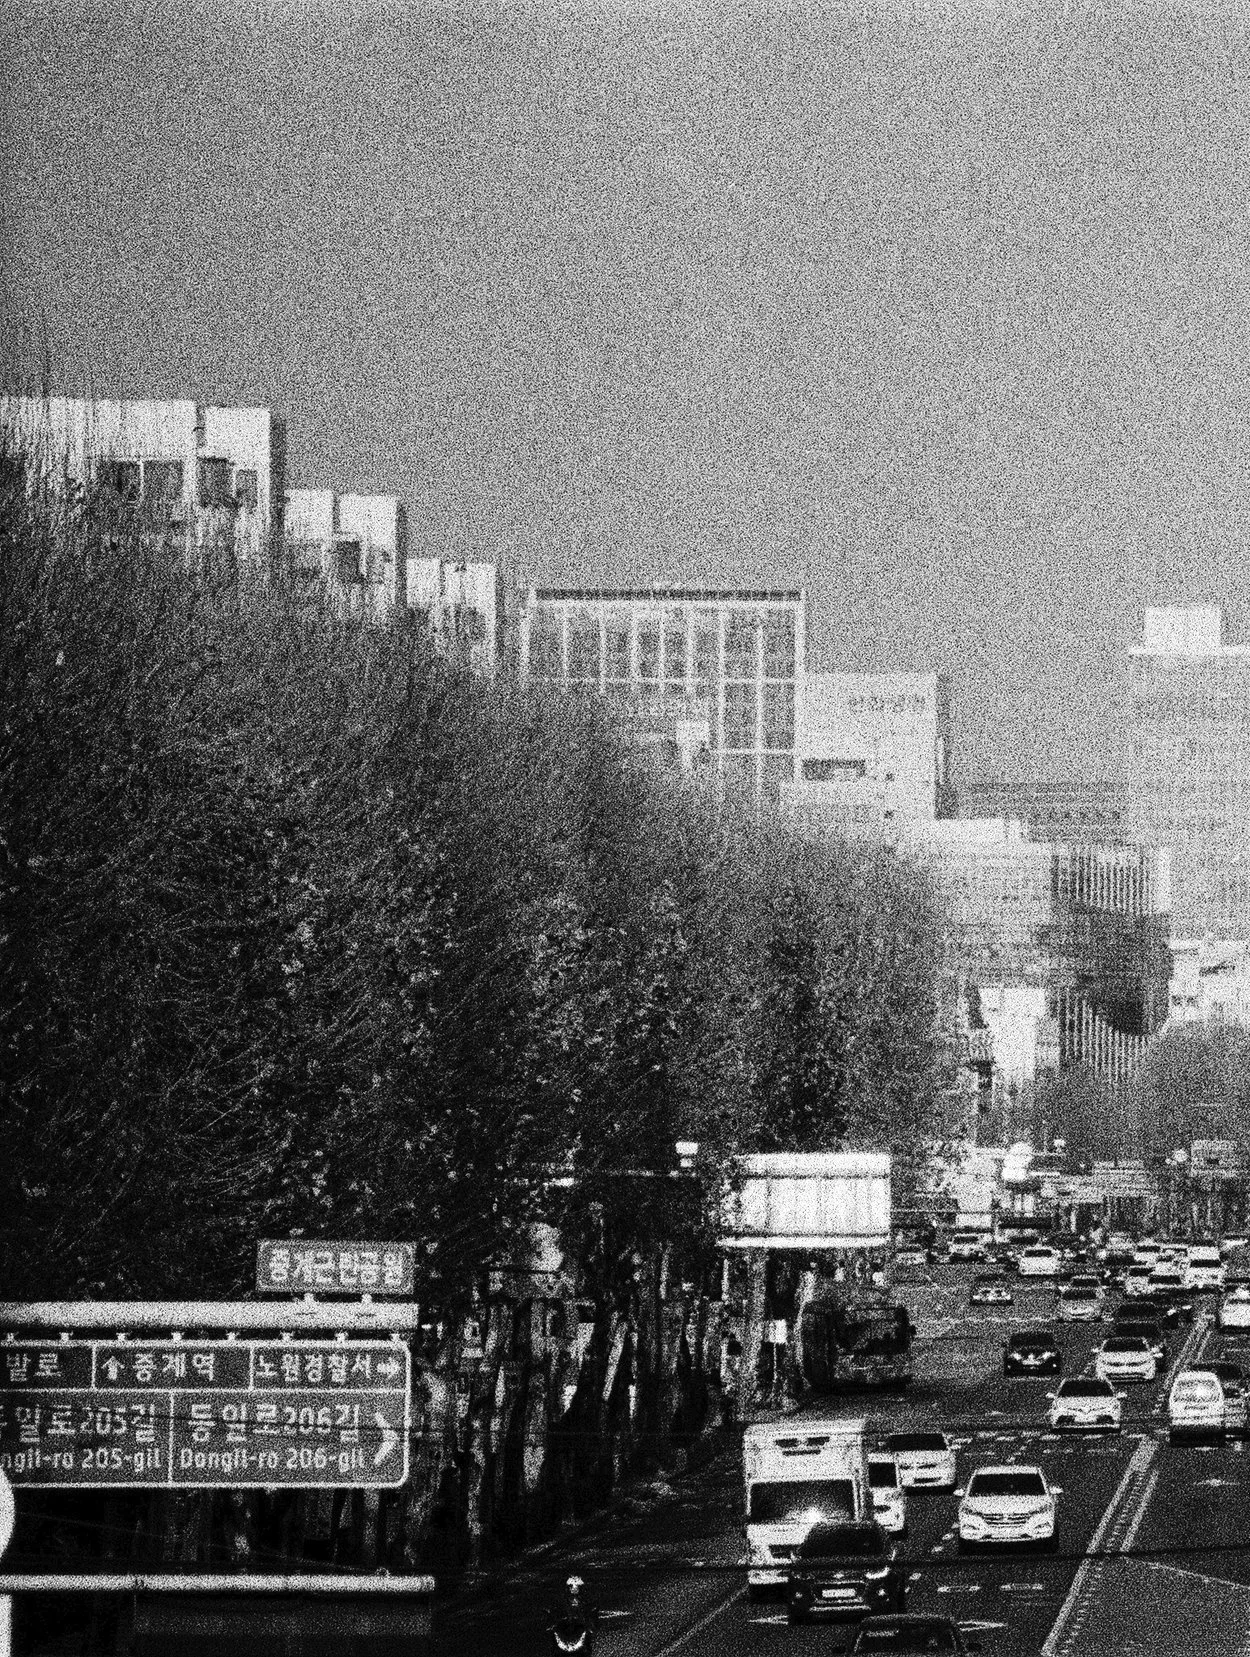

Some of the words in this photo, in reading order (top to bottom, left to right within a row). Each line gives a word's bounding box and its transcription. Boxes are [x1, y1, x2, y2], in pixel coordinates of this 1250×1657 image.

[268, 1248, 404, 1286] 중계근린공원
[132, 1353, 216, 1382] 중계역
[256, 1352, 372, 1384] 노원경찰서
[0, 1402, 156, 1443] 일로205길
[80, 1447, 161, 1474] 205-gil
[179, 1447, 279, 1474] Dongil-ro
[284, 1447, 366, 1474] 206-gil
